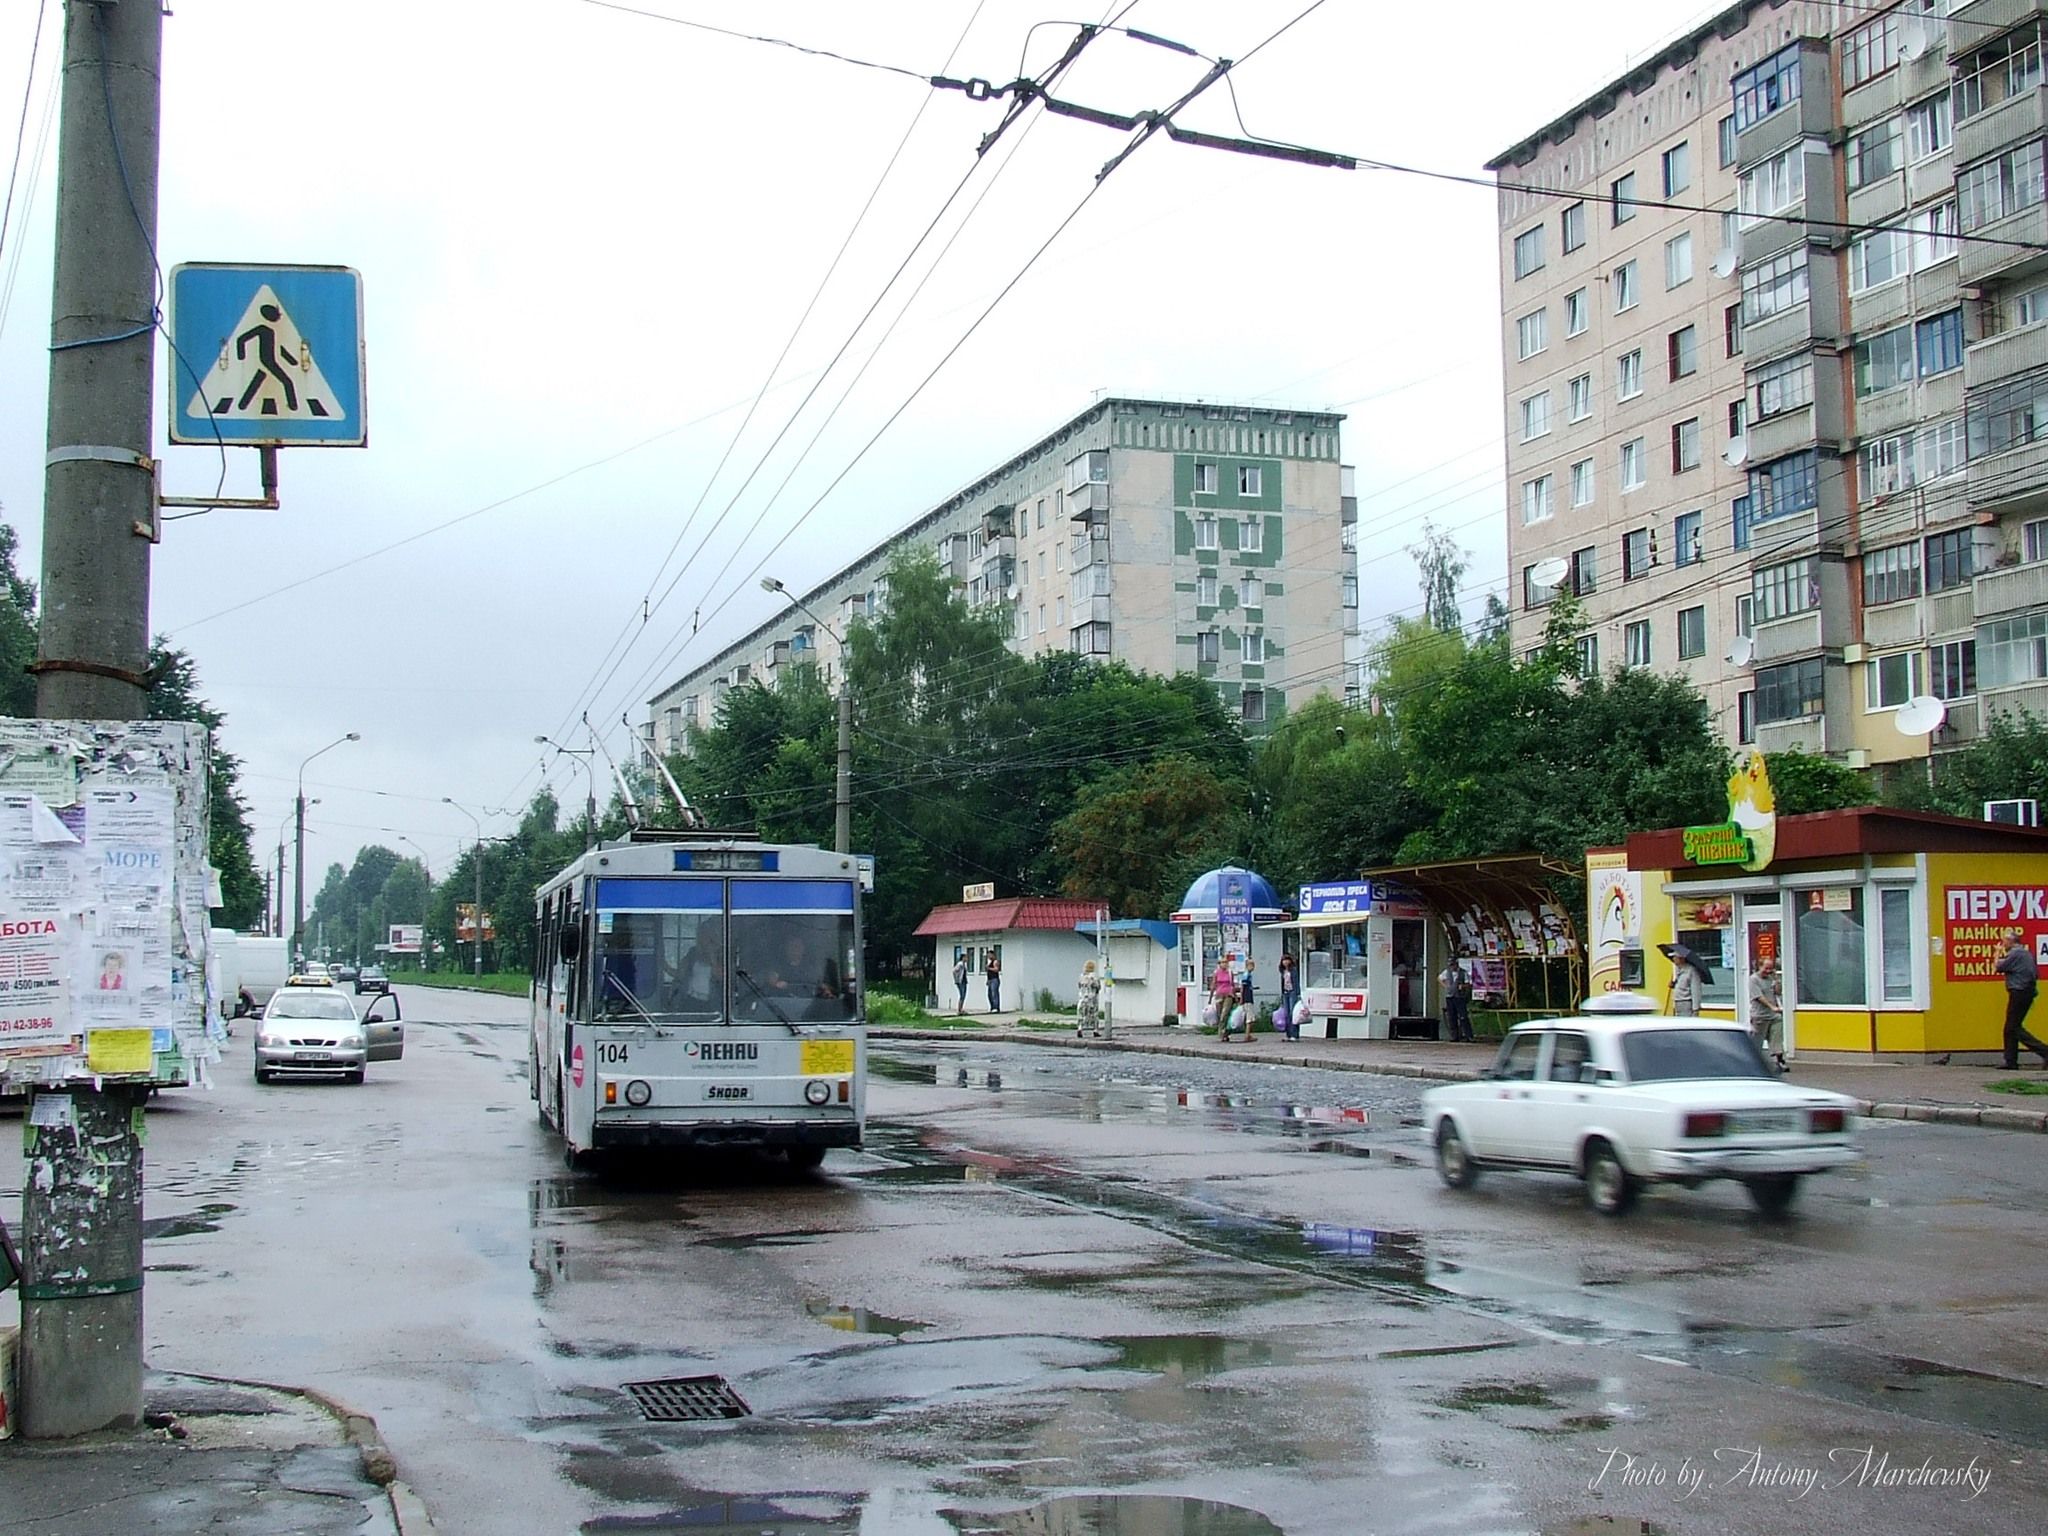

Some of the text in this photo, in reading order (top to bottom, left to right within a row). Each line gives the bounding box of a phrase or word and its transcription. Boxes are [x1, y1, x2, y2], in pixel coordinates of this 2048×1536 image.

[105, 851, 161, 869] МОРЕ
[1947, 889, 2048, 920] ПЕРУК
[0, 920, 56, 936] БОТА
[1953, 959, 2005, 976] МАКІ
[14, 979, 32, 990] 4500
[14, 1017, 53, 1031] 42-38-96
[598, 1044, 629, 1063] 104
[701, 1043, 759, 1060] REHAU
